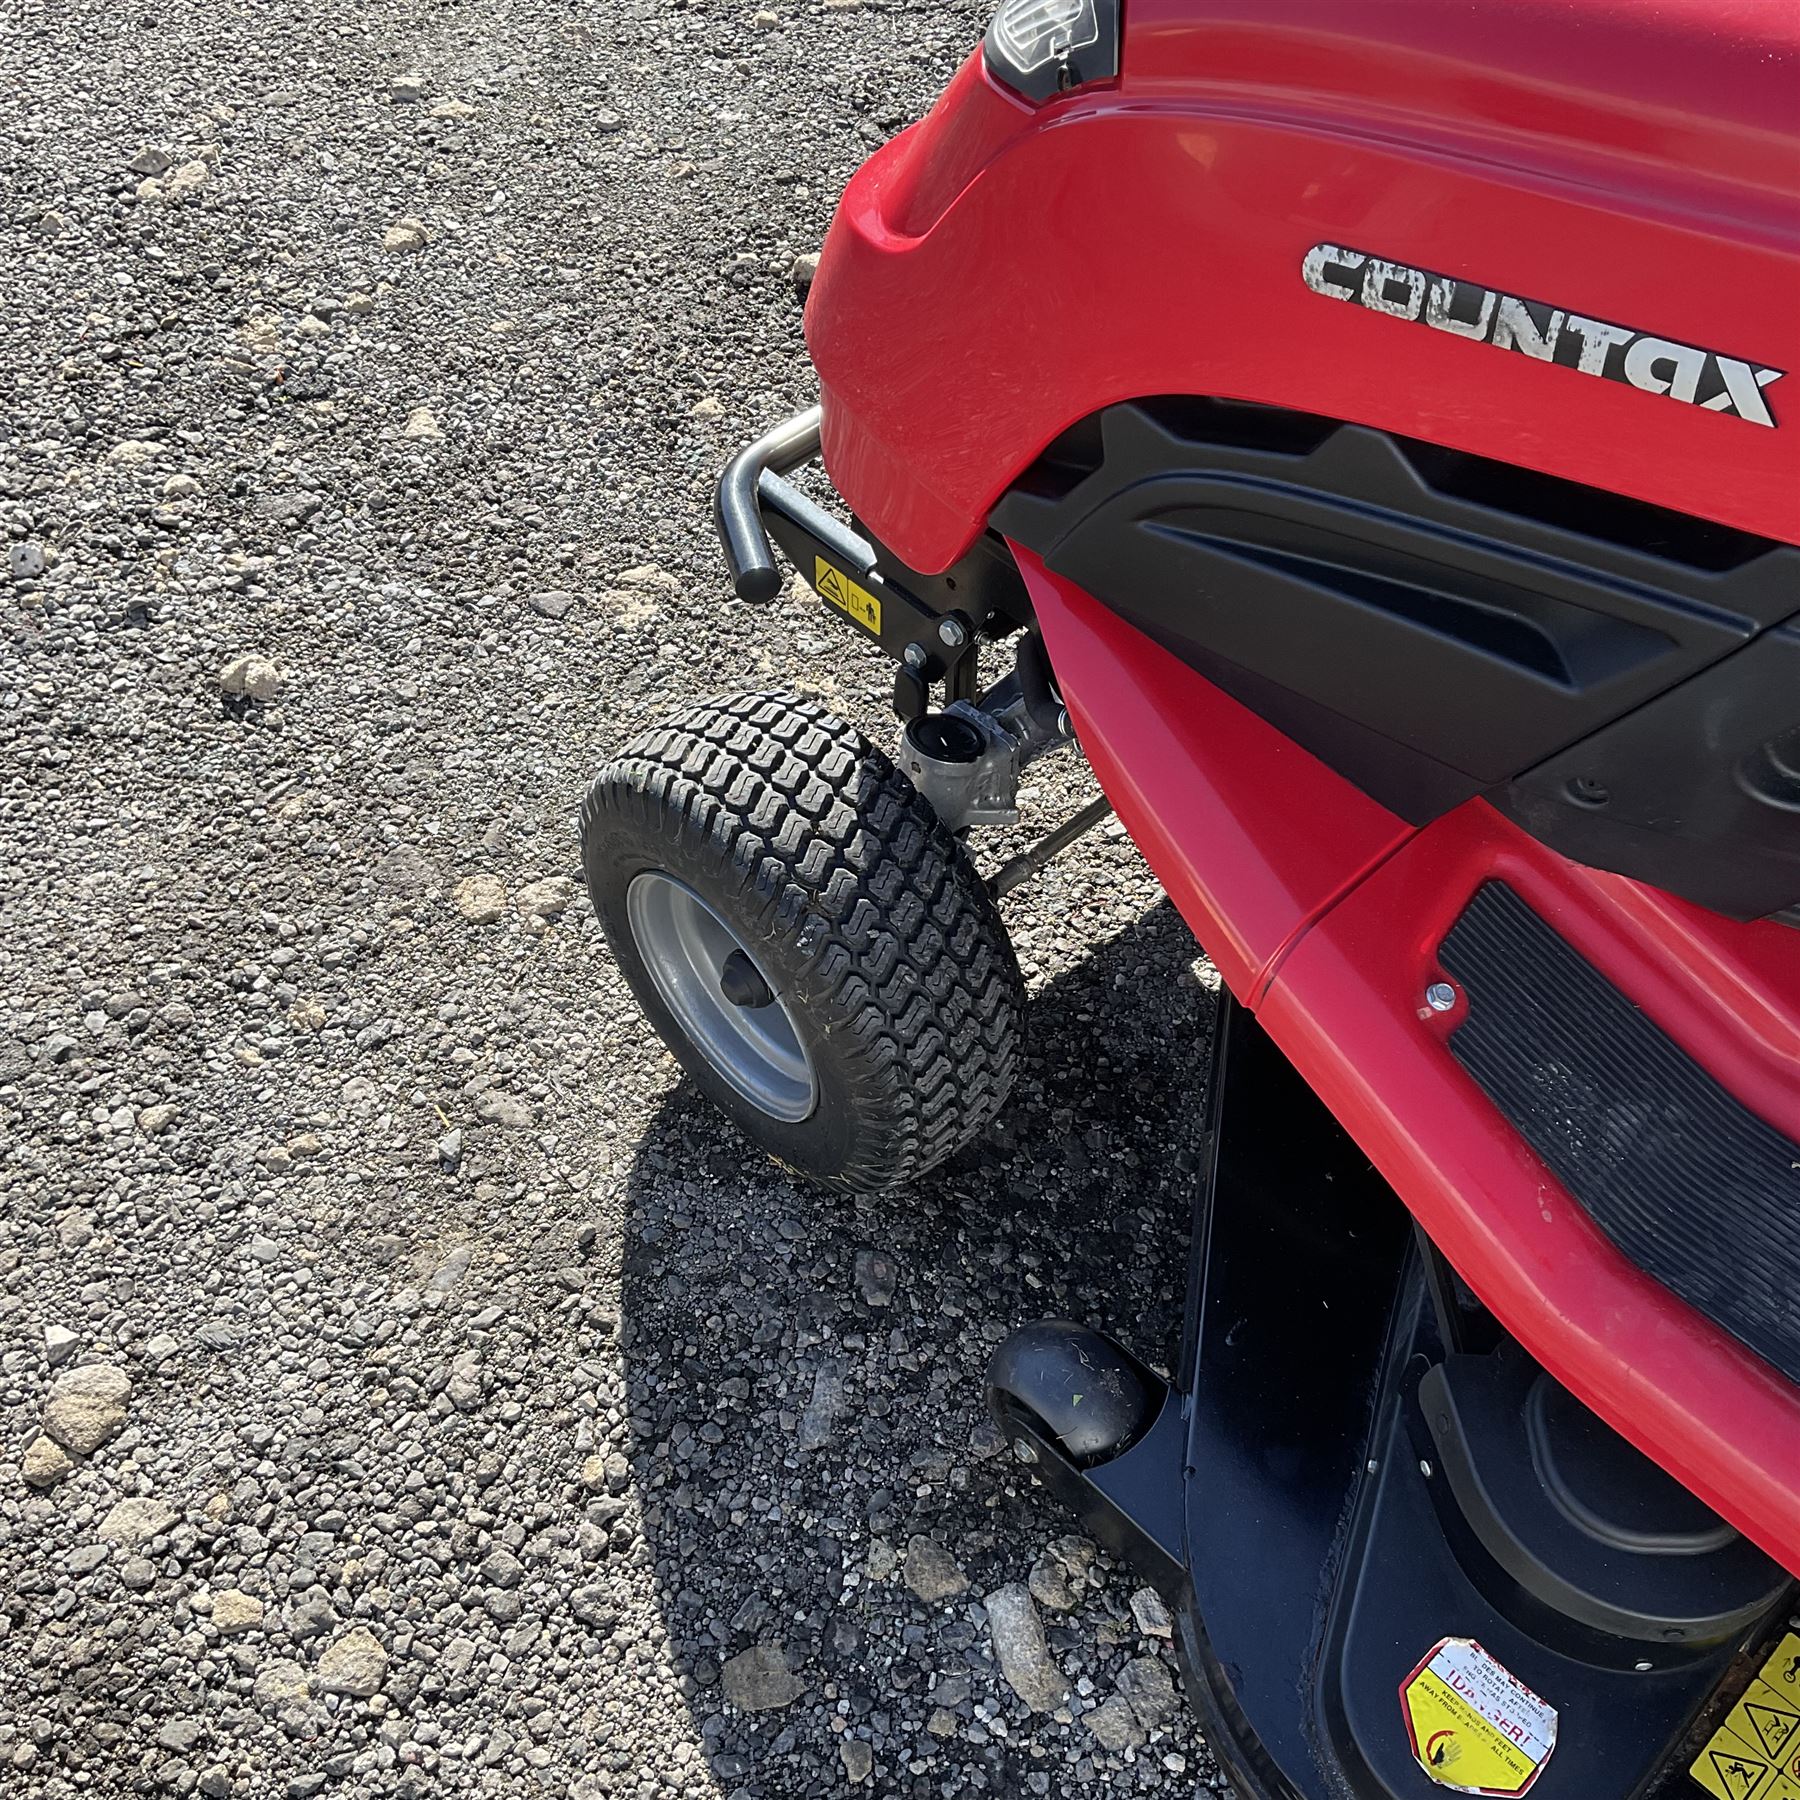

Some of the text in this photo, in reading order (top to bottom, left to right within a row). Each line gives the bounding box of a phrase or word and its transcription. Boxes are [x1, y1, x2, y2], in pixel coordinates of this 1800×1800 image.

[1470, 1652, 1496, 1676] BLDES
[1495, 1675, 1510, 1689] MAY
[1510, 1689, 1545, 1719] CONTINUE
[1473, 1665, 1483, 1675] TO
[1483, 1675, 1505, 1695] ROTAT
[1420, 1681, 1440, 1698] AWAY
[1439, 1697, 1457, 1716] FROM
[1491, 1745, 1503, 1759] ALL
[1504, 1757, 1525, 1776] TIMES
[1441, 1690, 1460, 1707] KEEP
[1494, 1737, 1512, 1753] FEET
